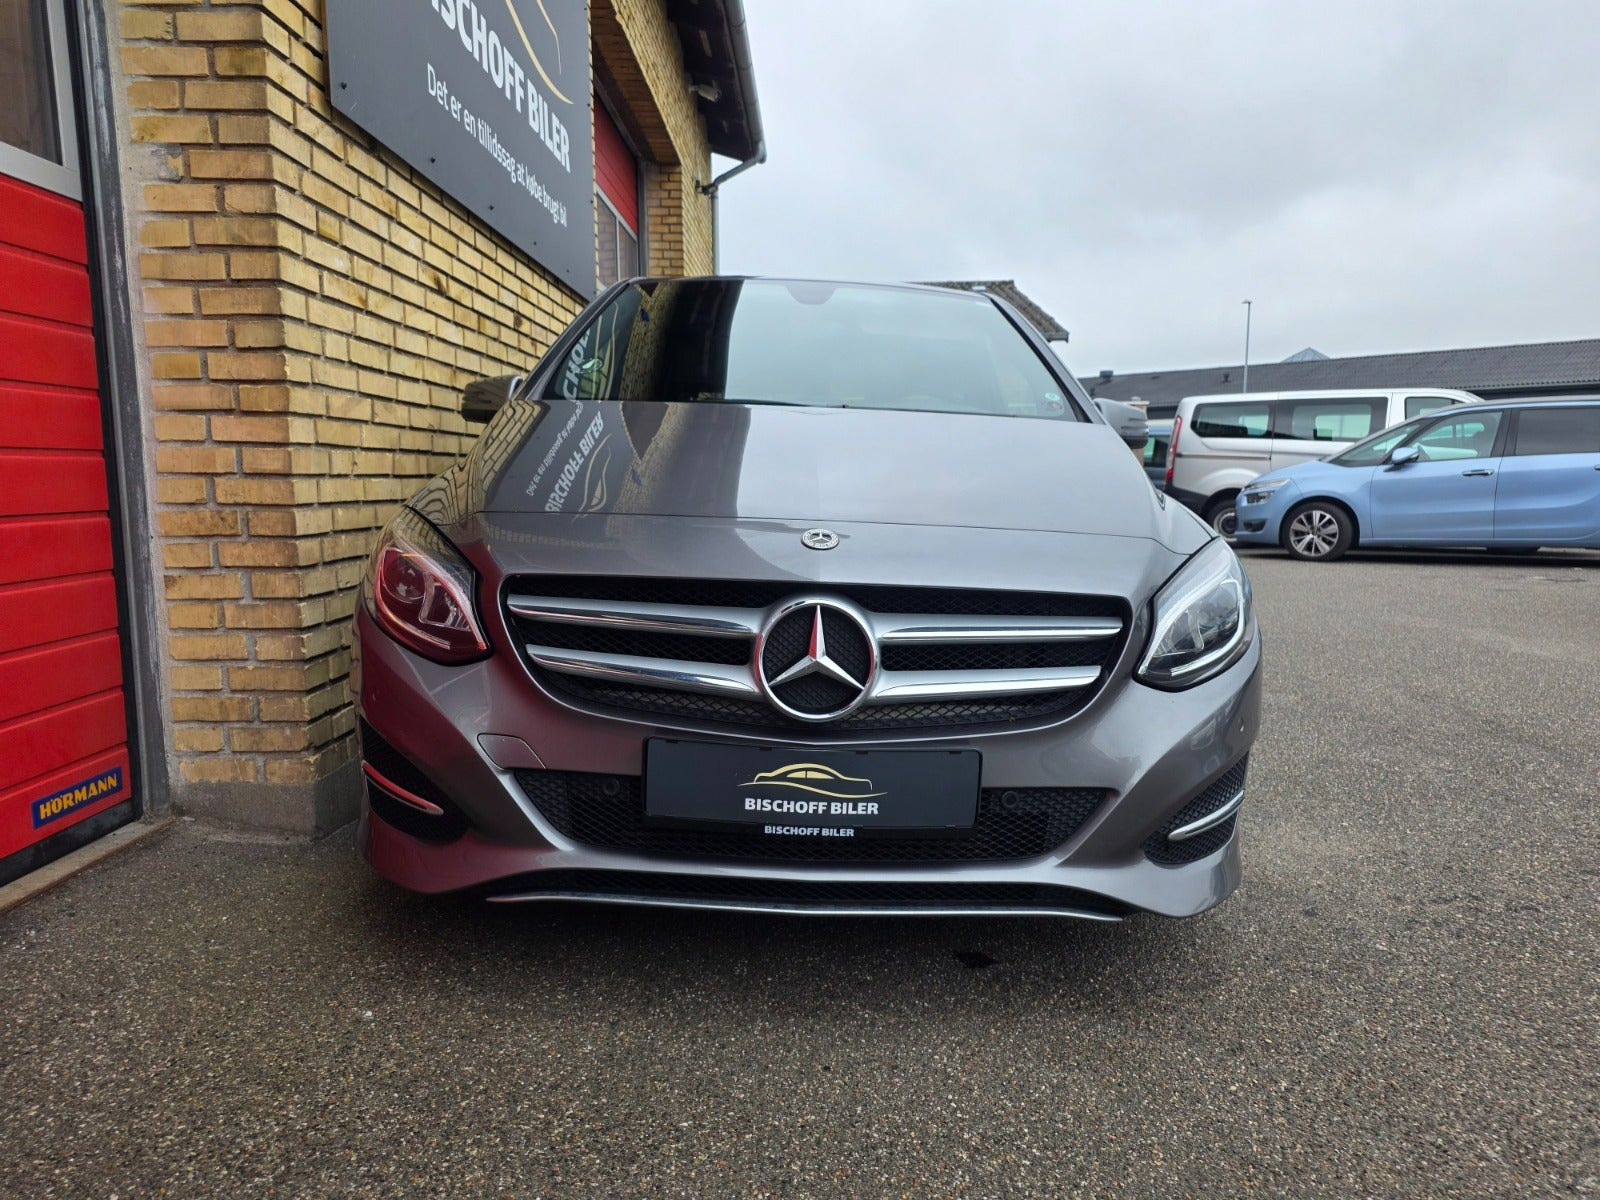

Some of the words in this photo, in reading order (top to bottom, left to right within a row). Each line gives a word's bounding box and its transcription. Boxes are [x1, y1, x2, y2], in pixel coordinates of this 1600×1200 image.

[431, 0, 525, 113] SCHOFF
[527, 78, 571, 173] BILER
[427, 62, 449, 111] Det
[450, 95, 462, 122] er
[463, 108, 477, 138] en
[477, 117, 516, 184] tillidssag
[516, 163, 525, 187] at
[542, 183, 559, 224] brugt
[559, 202, 568, 228] bil
[39, 773, 118, 820] HÖRMANN
[744, 798, 828, 814] BISCHOFF
[830, 801, 879, 815] BILER
[764, 825, 821, 836] BISCHOFF
[821, 827, 855, 837] BILER
